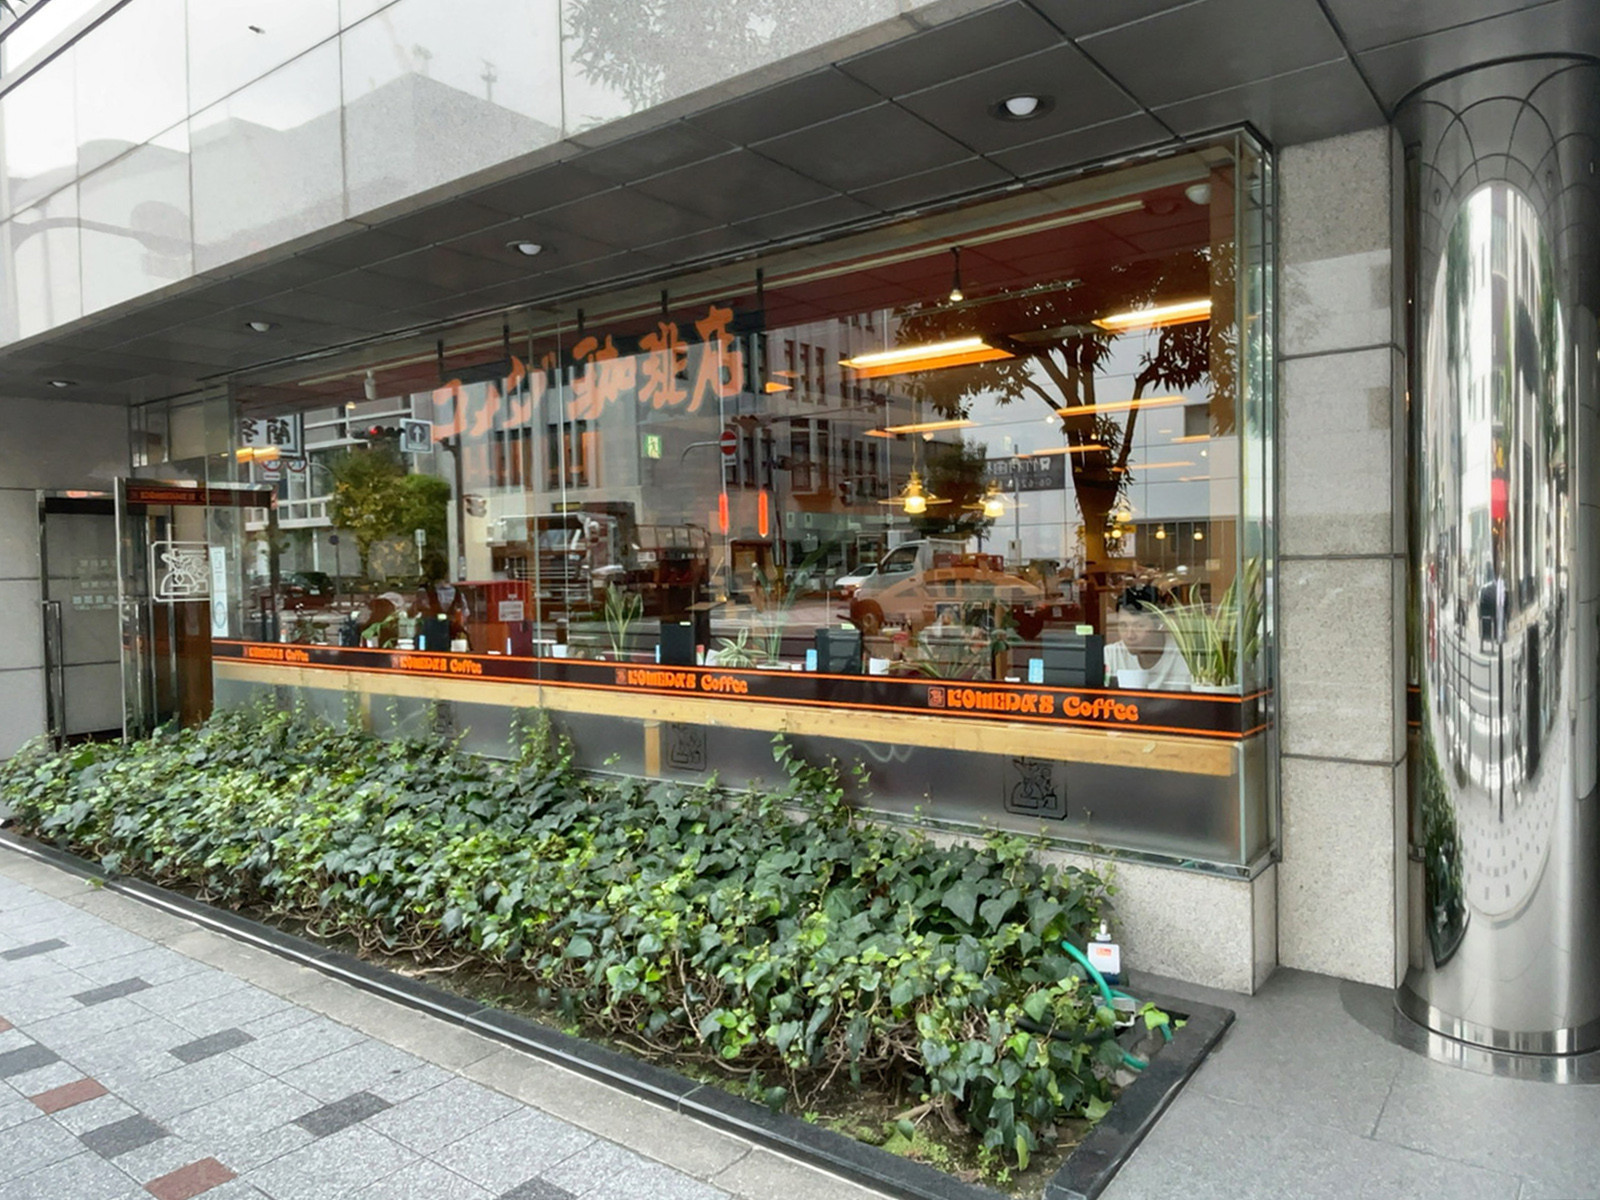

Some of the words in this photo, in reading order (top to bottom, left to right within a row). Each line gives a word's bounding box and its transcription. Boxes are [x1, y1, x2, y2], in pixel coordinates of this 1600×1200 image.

[450, 659, 482, 674] Coffee
[701, 674, 748, 693] Coffee
[1063, 696, 1139, 721] Coffee
